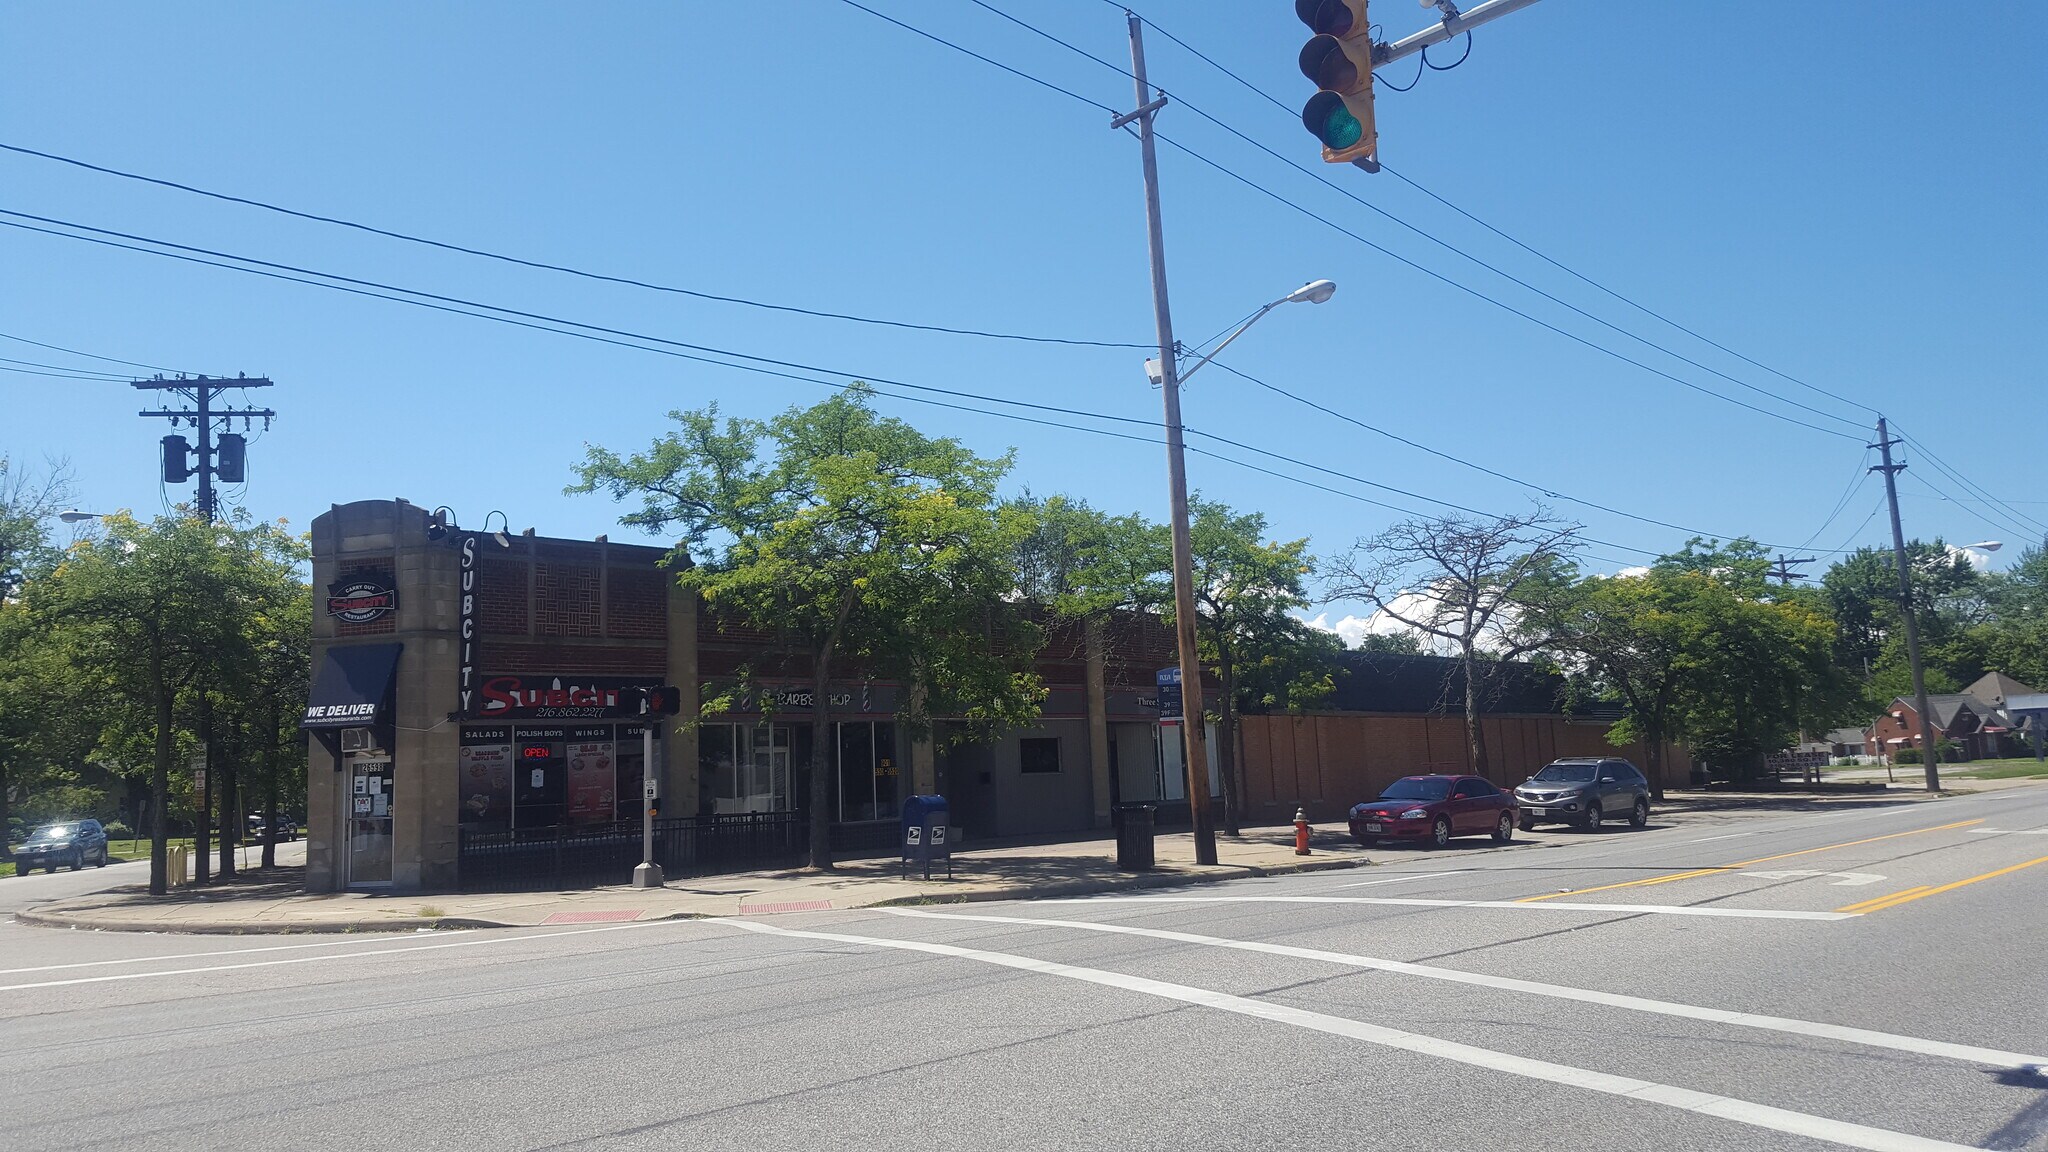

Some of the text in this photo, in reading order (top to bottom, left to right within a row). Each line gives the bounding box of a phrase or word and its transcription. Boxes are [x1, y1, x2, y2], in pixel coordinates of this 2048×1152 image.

[345, 585, 363, 593] CARRY
[344, 610, 376, 620] RESTAURANT
[461, 537, 475, 711] SUBCITY
[480, 676, 620, 716] SUBCIT
[777, 692, 813, 706] BARBE
[828, 694, 851, 706] HOP
[1137, 697, 1156, 706] Three
[307, 703, 375, 717] WE DELIVER
[524, 747, 549, 757] OPEN
